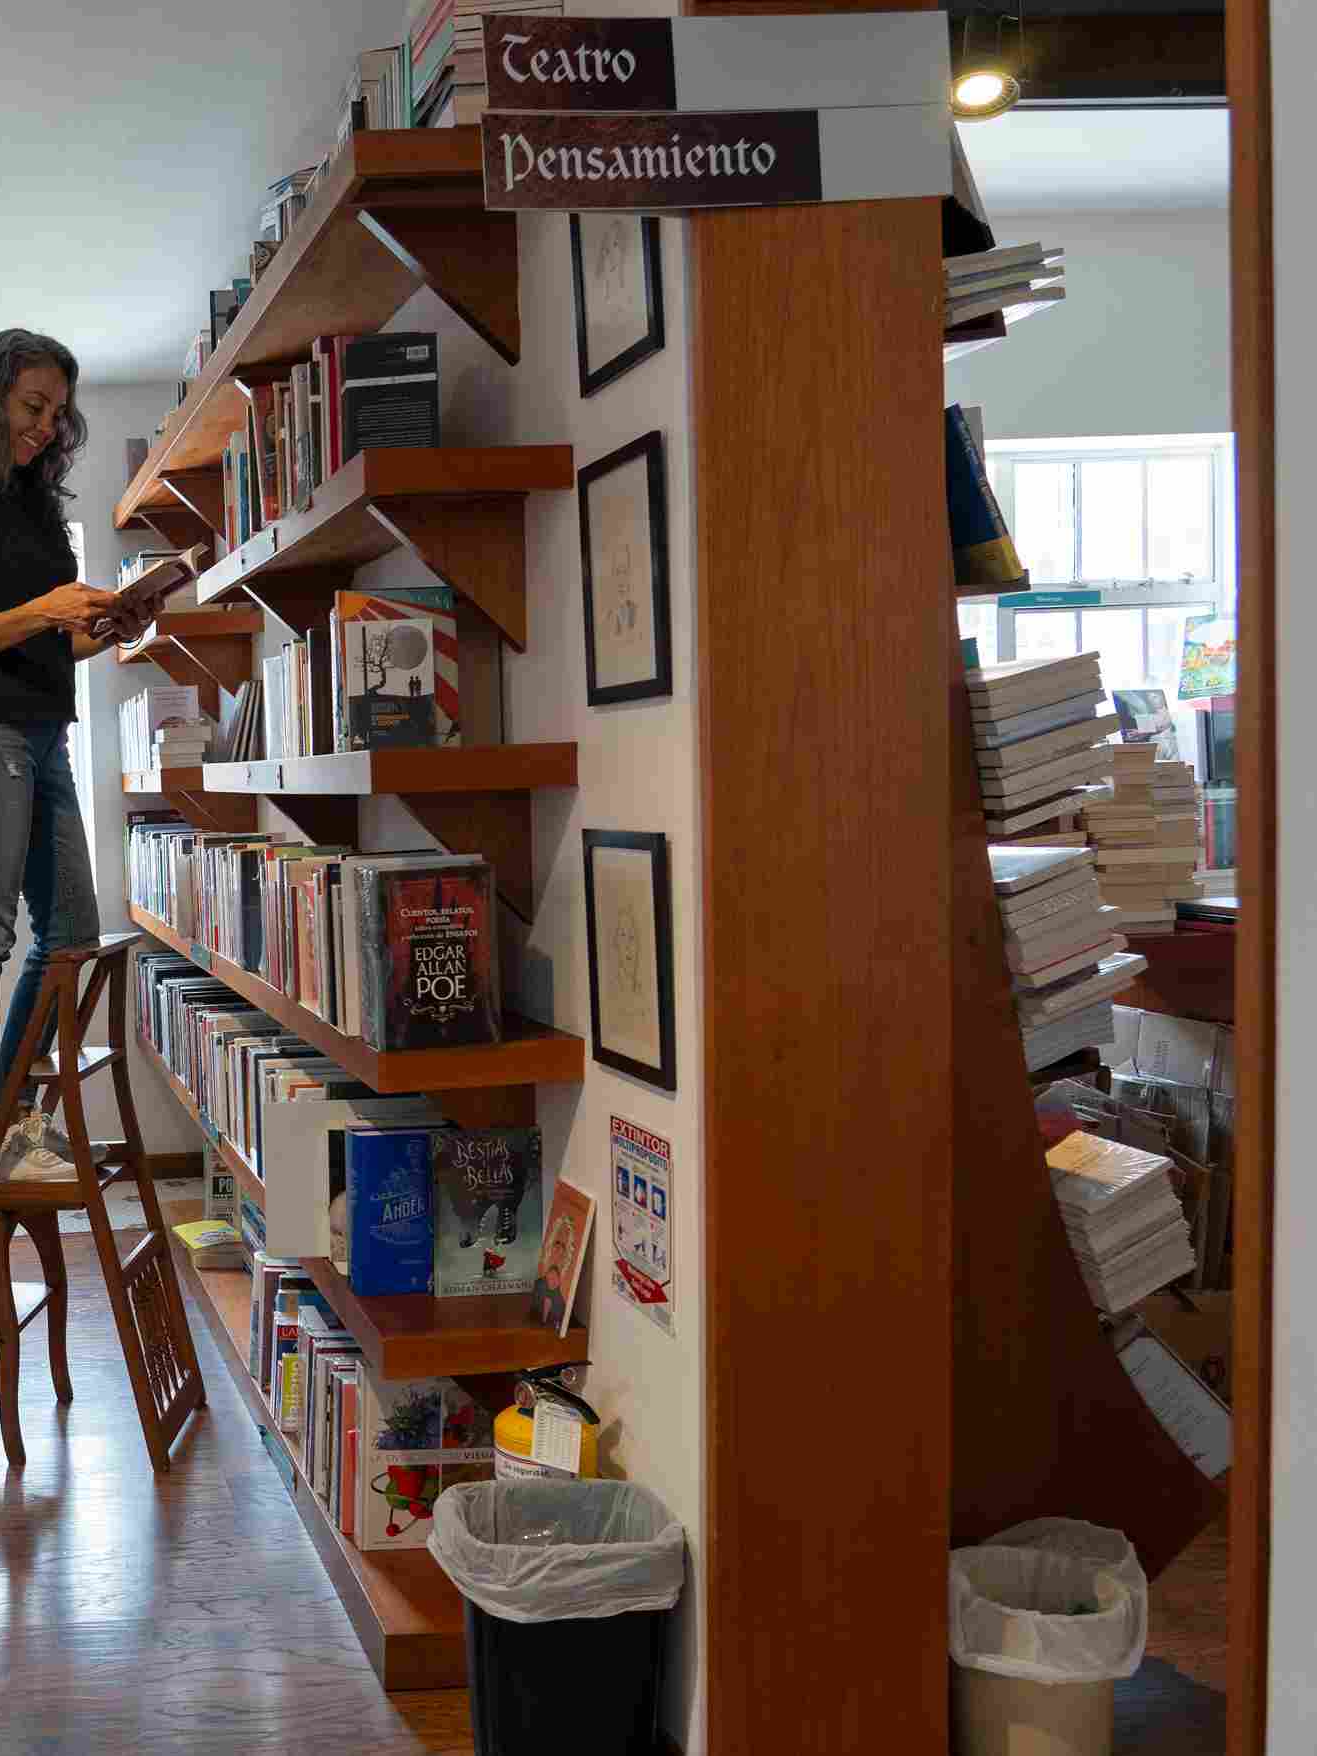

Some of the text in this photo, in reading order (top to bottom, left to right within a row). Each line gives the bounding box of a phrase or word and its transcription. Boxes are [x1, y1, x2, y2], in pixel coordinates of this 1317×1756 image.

[500, 33, 636, 83] Teatro
[499, 132, 777, 192] Pensamiento
[415, 945, 466, 961] EDGAR
[416, 959, 467, 976] ALLAN
[416, 975, 467, 1001] POE
[611, 1117, 669, 1158] EXTINTOR
[452, 1139, 510, 1167] BESTIAS
[464, 1164, 514, 1190] BELLAS
